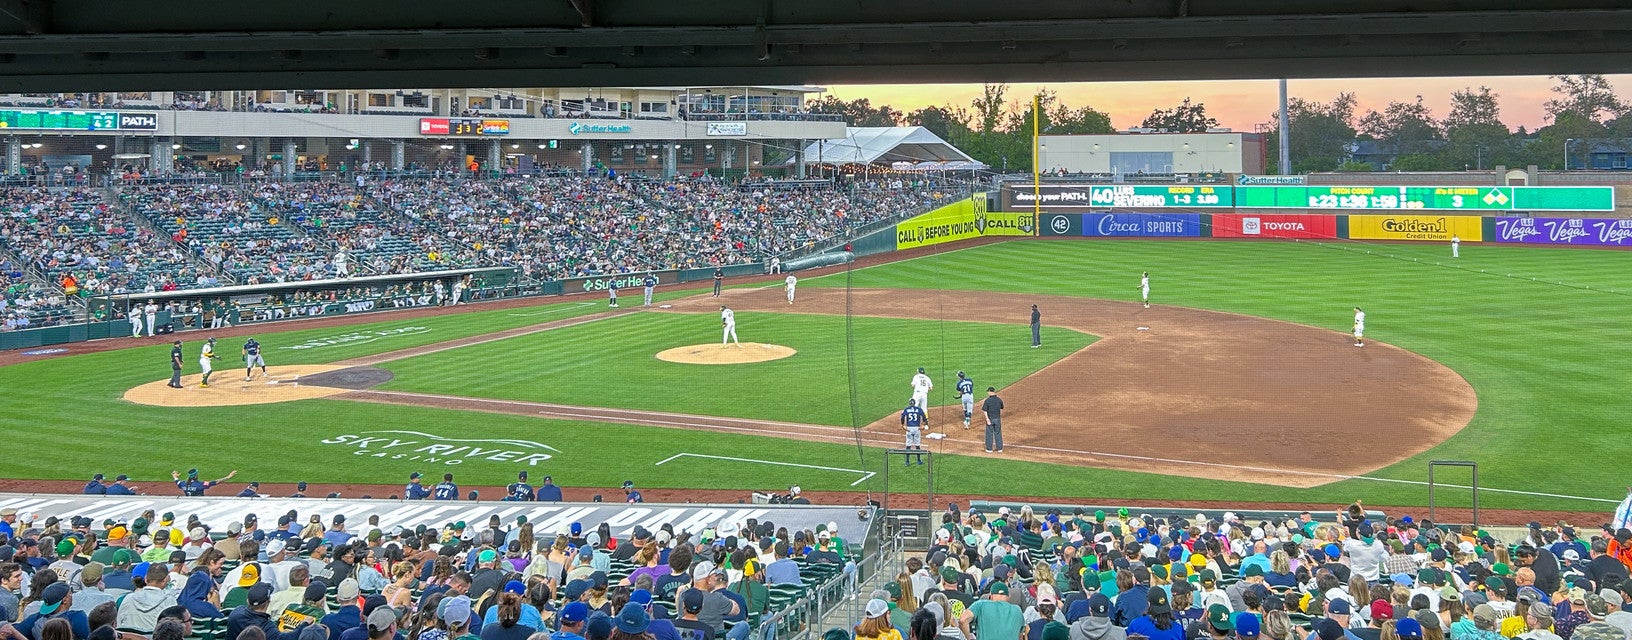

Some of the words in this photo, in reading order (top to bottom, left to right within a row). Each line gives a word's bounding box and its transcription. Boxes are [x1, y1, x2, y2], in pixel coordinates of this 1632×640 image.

[583, 123, 606, 133] Sutter
[608, 123, 632, 133] Health
[612, 147, 622, 156] 24
[684, 147, 693, 156] 34
[1250, 176, 1274, 184] Sutter
[1276, 176, 1304, 184] Health
[1092, 188, 1113, 203] 40
[1113, 195, 1166, 206] SEVERINO
[1452, 195, 1463, 207] 3
[988, 220, 1016, 228] CALL
[1054, 221, 1066, 229] 42
[1098, 214, 1141, 236] Circa
[1147, 222, 1183, 233] SPORTS
[1264, 222, 1304, 230] TOYOTA
[898, 230, 916, 243] CALL
[925, 225, 949, 239] BEFORE
[951, 222, 963, 235] YOU
[964, 221, 974, 233] DIG
[1496, 219, 1541, 241] Vegas
[1544, 220, 1590, 243] Vegas
[908, 413, 918, 421] 53
[321, 435, 418, 449] SKY
[414, 443, 553, 466] RIVER
[353, 450, 463, 465] CASINO
[436, 489, 449, 498] 44
